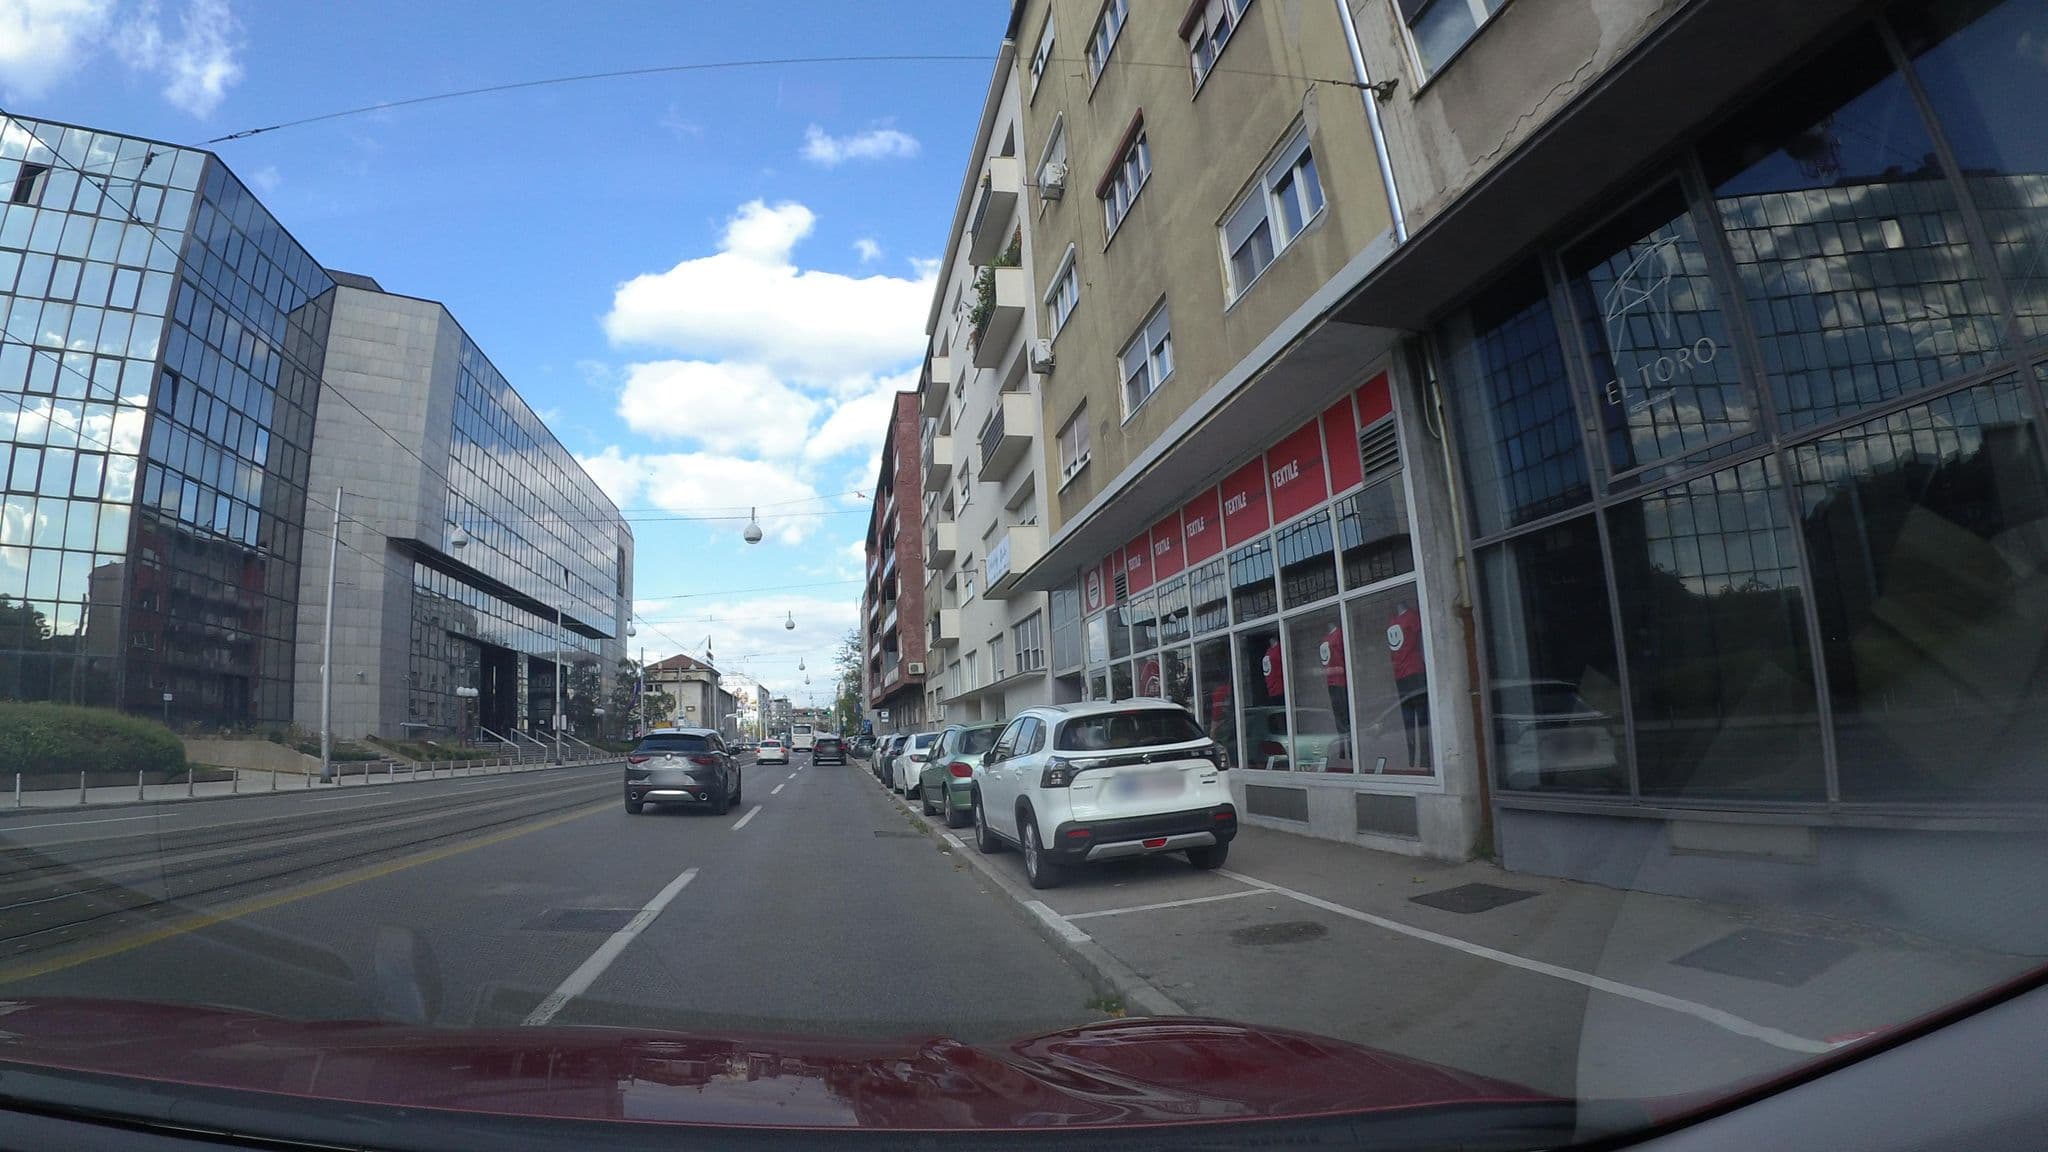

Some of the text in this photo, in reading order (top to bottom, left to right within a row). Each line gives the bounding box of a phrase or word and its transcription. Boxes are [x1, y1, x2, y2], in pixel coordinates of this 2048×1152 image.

[1606, 377, 1632, 406] EL
[1637, 337, 1716, 389] TORO
[1272, 460, 1298, 488] TEXTILE
[1225, 491, 1246, 516] TEXTILE
[1186, 516, 1204, 537] TEXTILE
